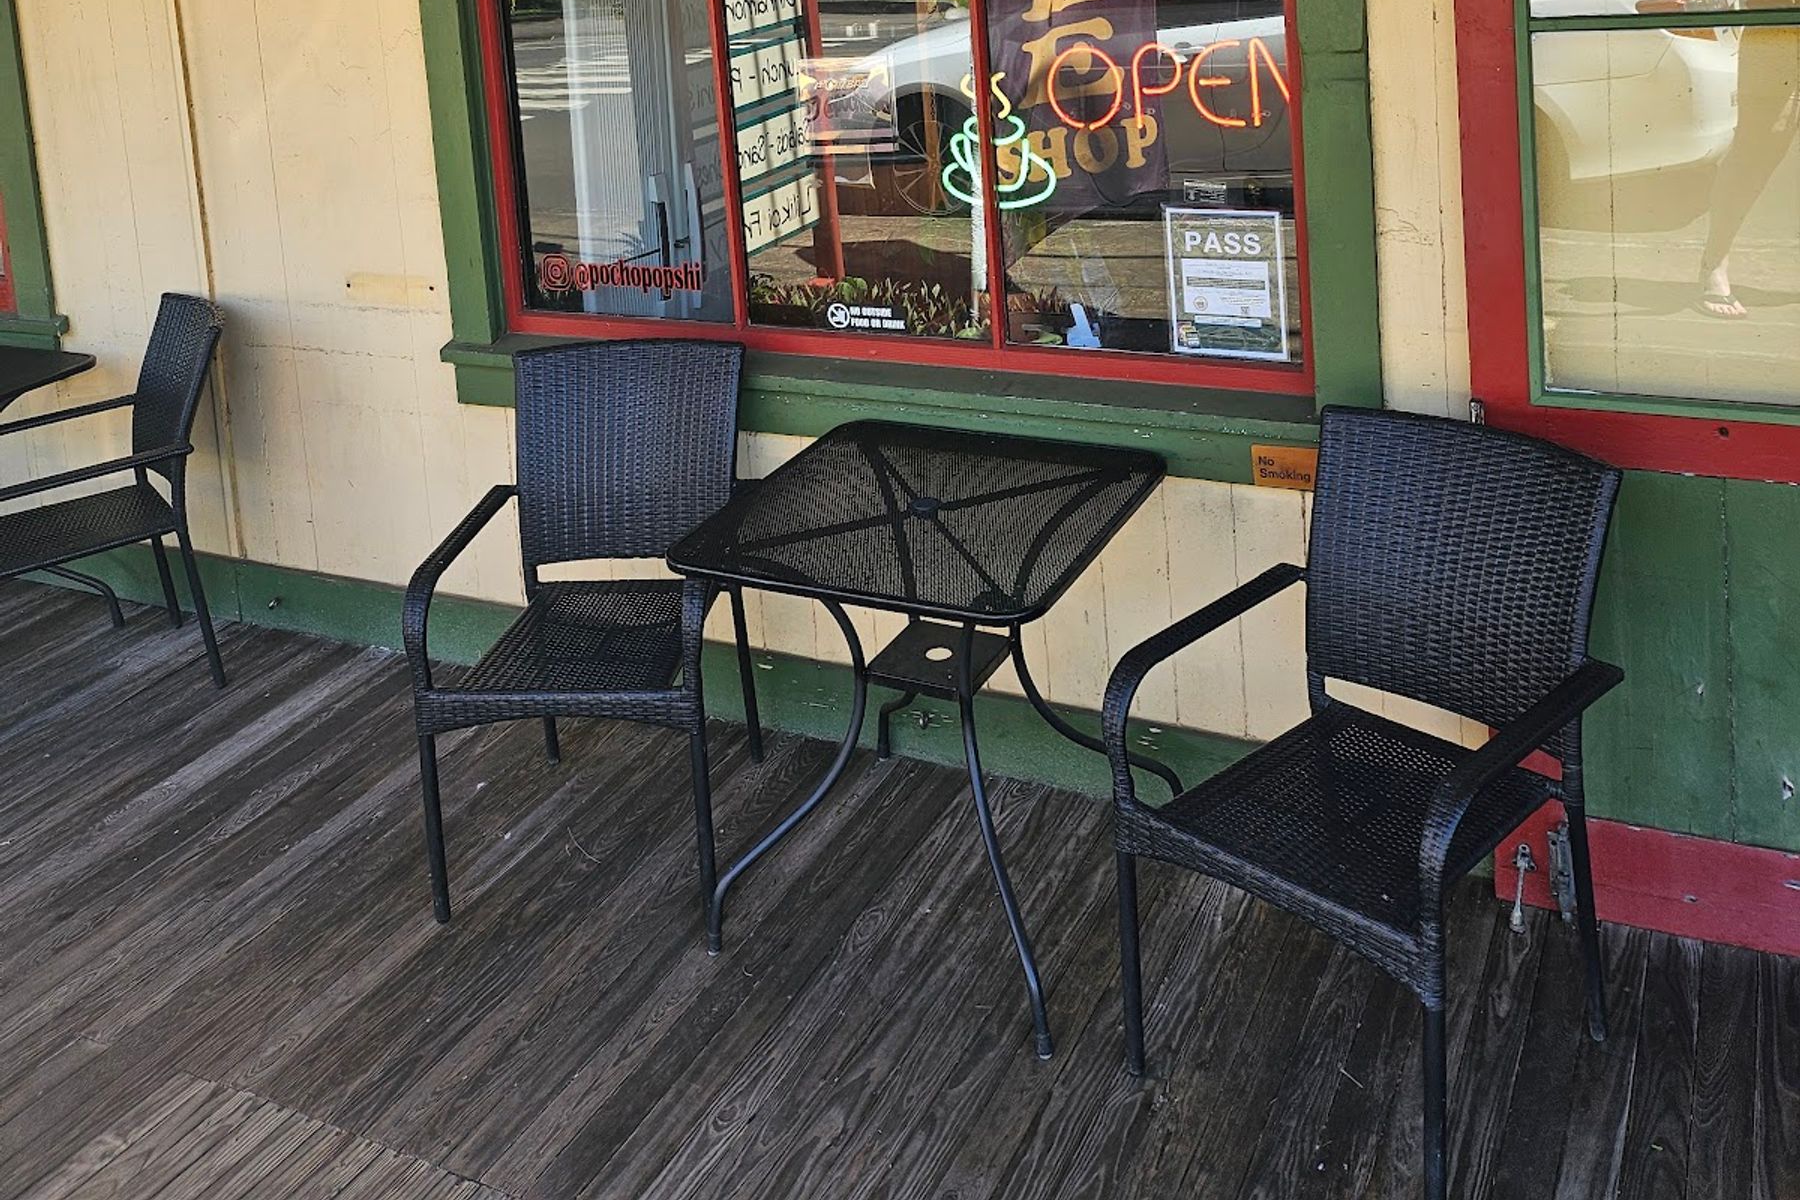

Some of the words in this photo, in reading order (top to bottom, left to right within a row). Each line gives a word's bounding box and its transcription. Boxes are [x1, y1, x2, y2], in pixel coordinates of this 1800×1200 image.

[1047, 38, 1290, 130] OPEN
[997, 114, 1159, 186] SHOP
[1184, 230, 1262, 255] PASS
[574, 259, 702, 296] @pochopopshi
[849, 306, 861, 316] NO
[861, 307, 892, 318] OUTSIDE
[850, 317, 870, 328] FOOD
[870, 318, 882, 329] OR
[882, 319, 906, 330] DRINK
[1258, 455, 1275, 467] No
[1259, 467, 1311, 484] Smoking
